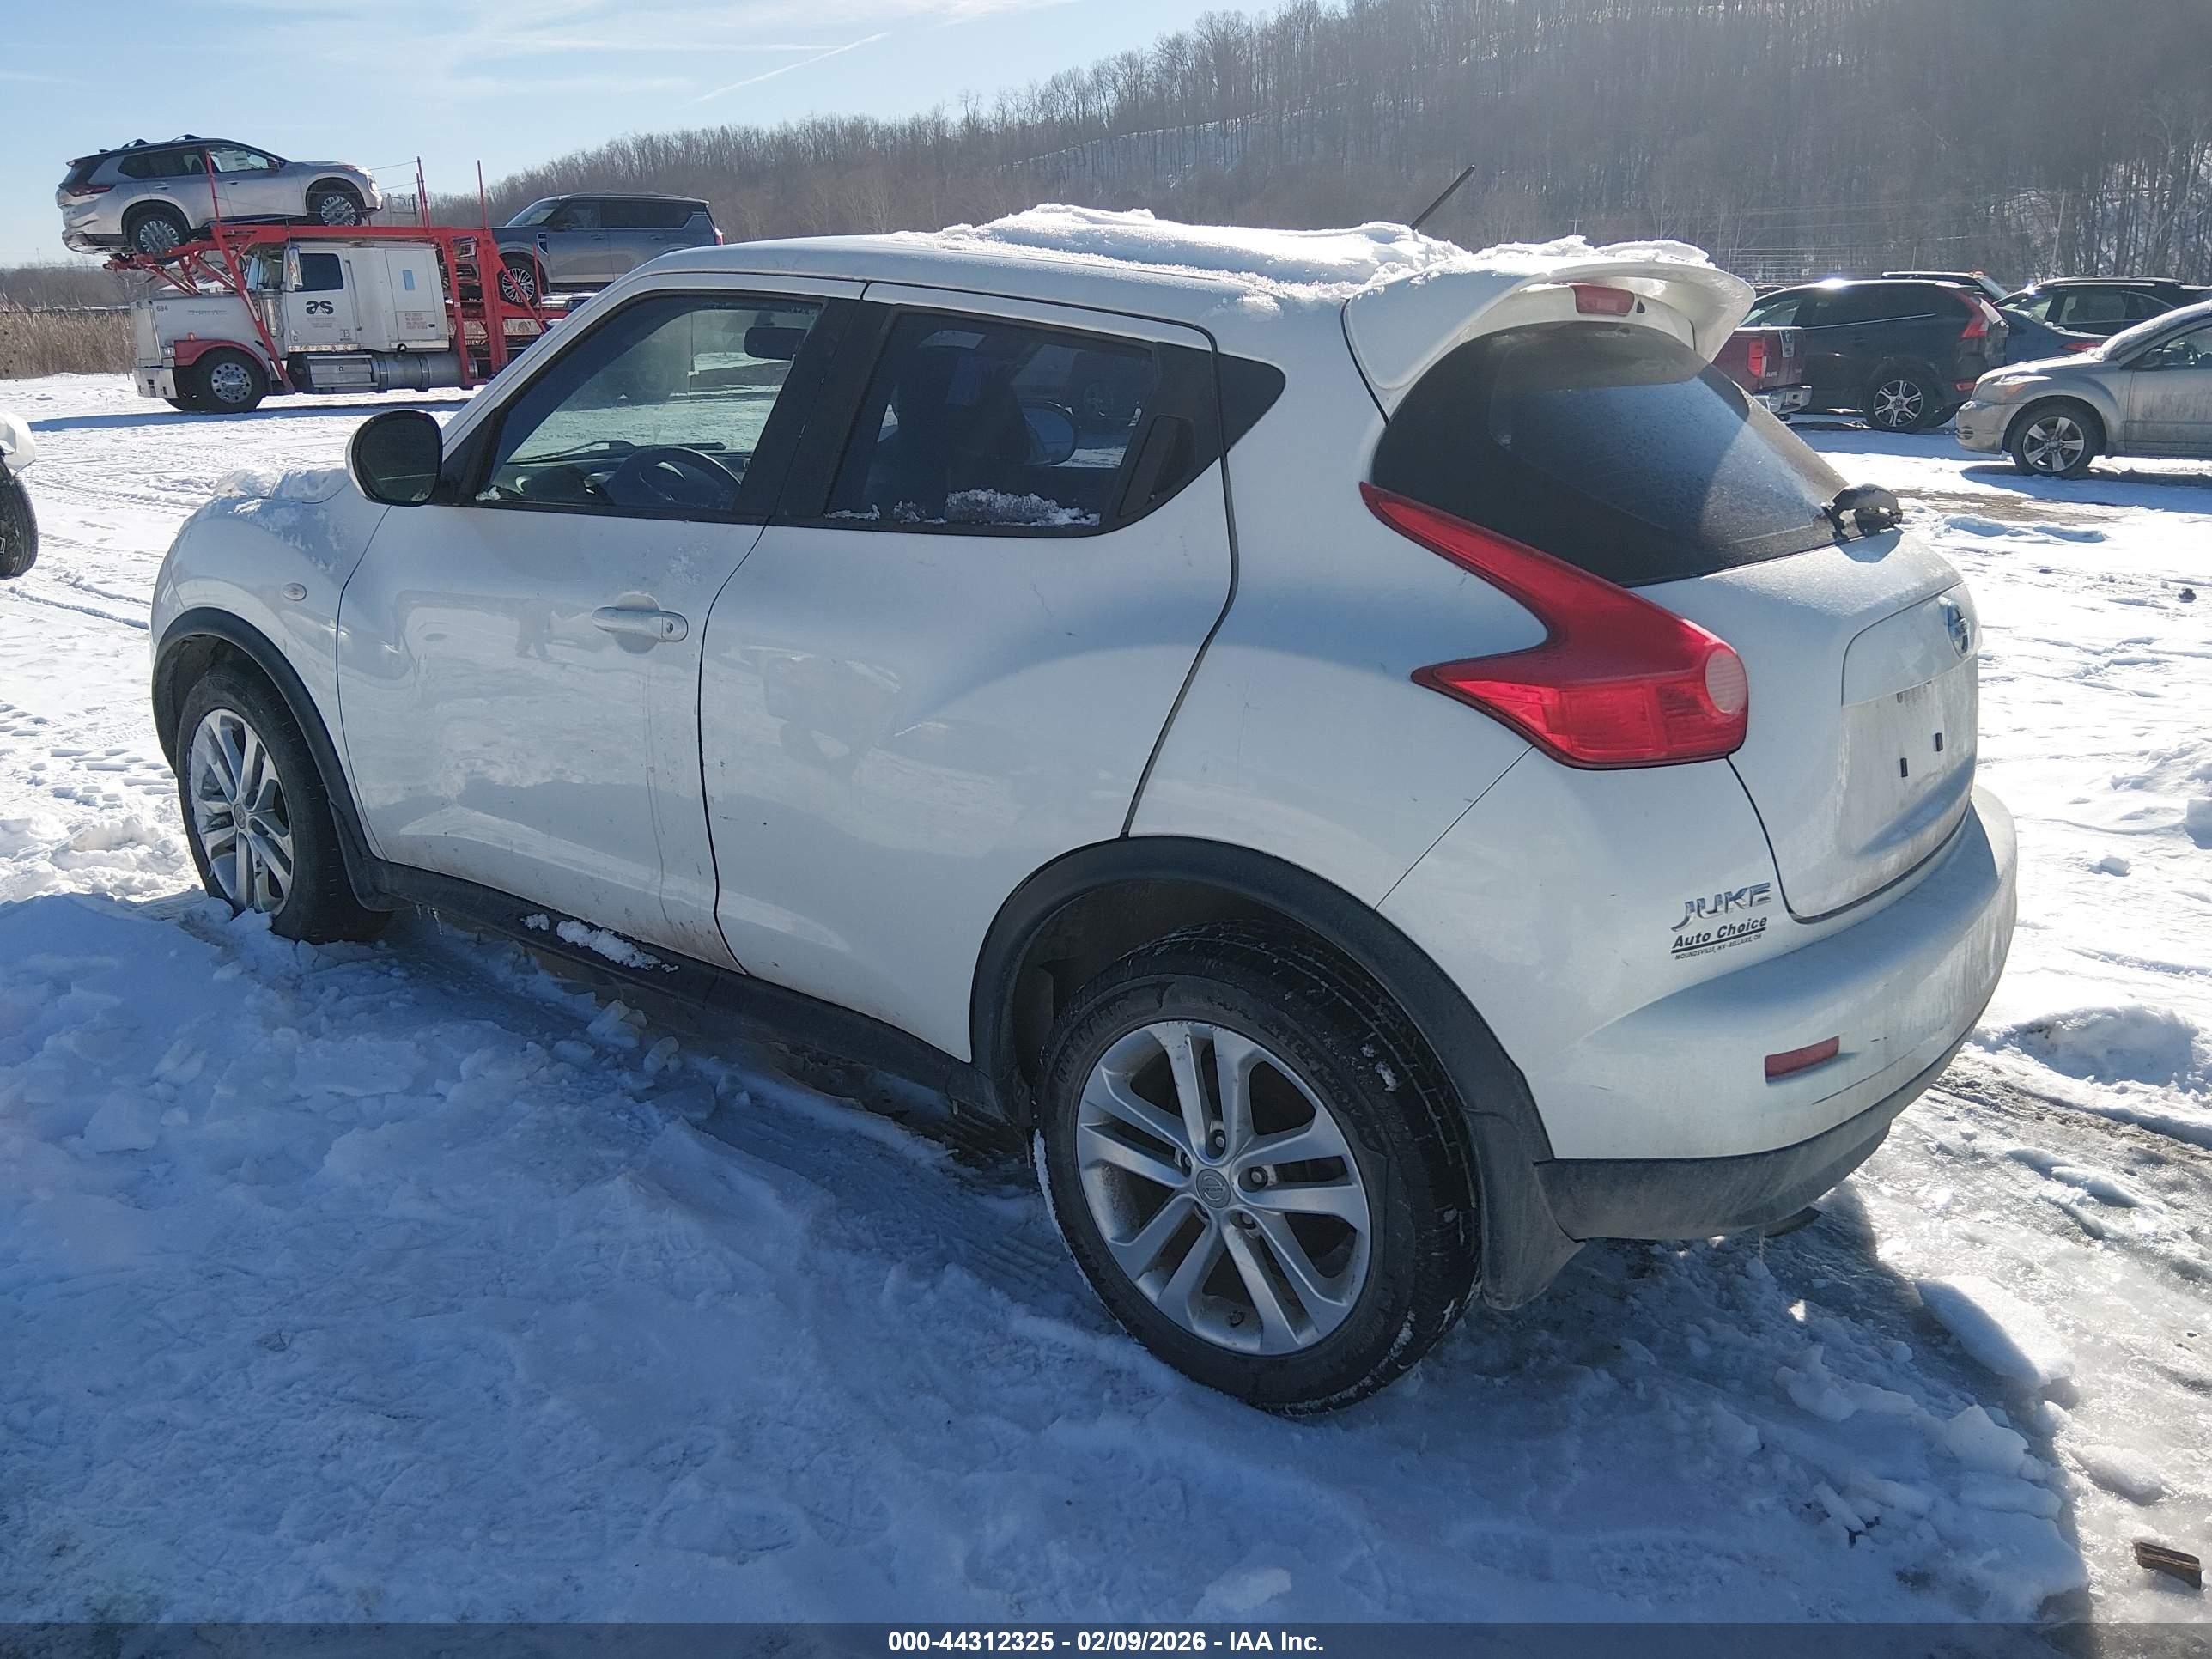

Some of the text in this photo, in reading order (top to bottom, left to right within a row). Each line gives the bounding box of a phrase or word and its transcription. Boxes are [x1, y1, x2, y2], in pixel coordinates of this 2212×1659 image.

[1670, 882, 1771, 932] JUKE
[1672, 916, 1767, 949] Auto Choice
